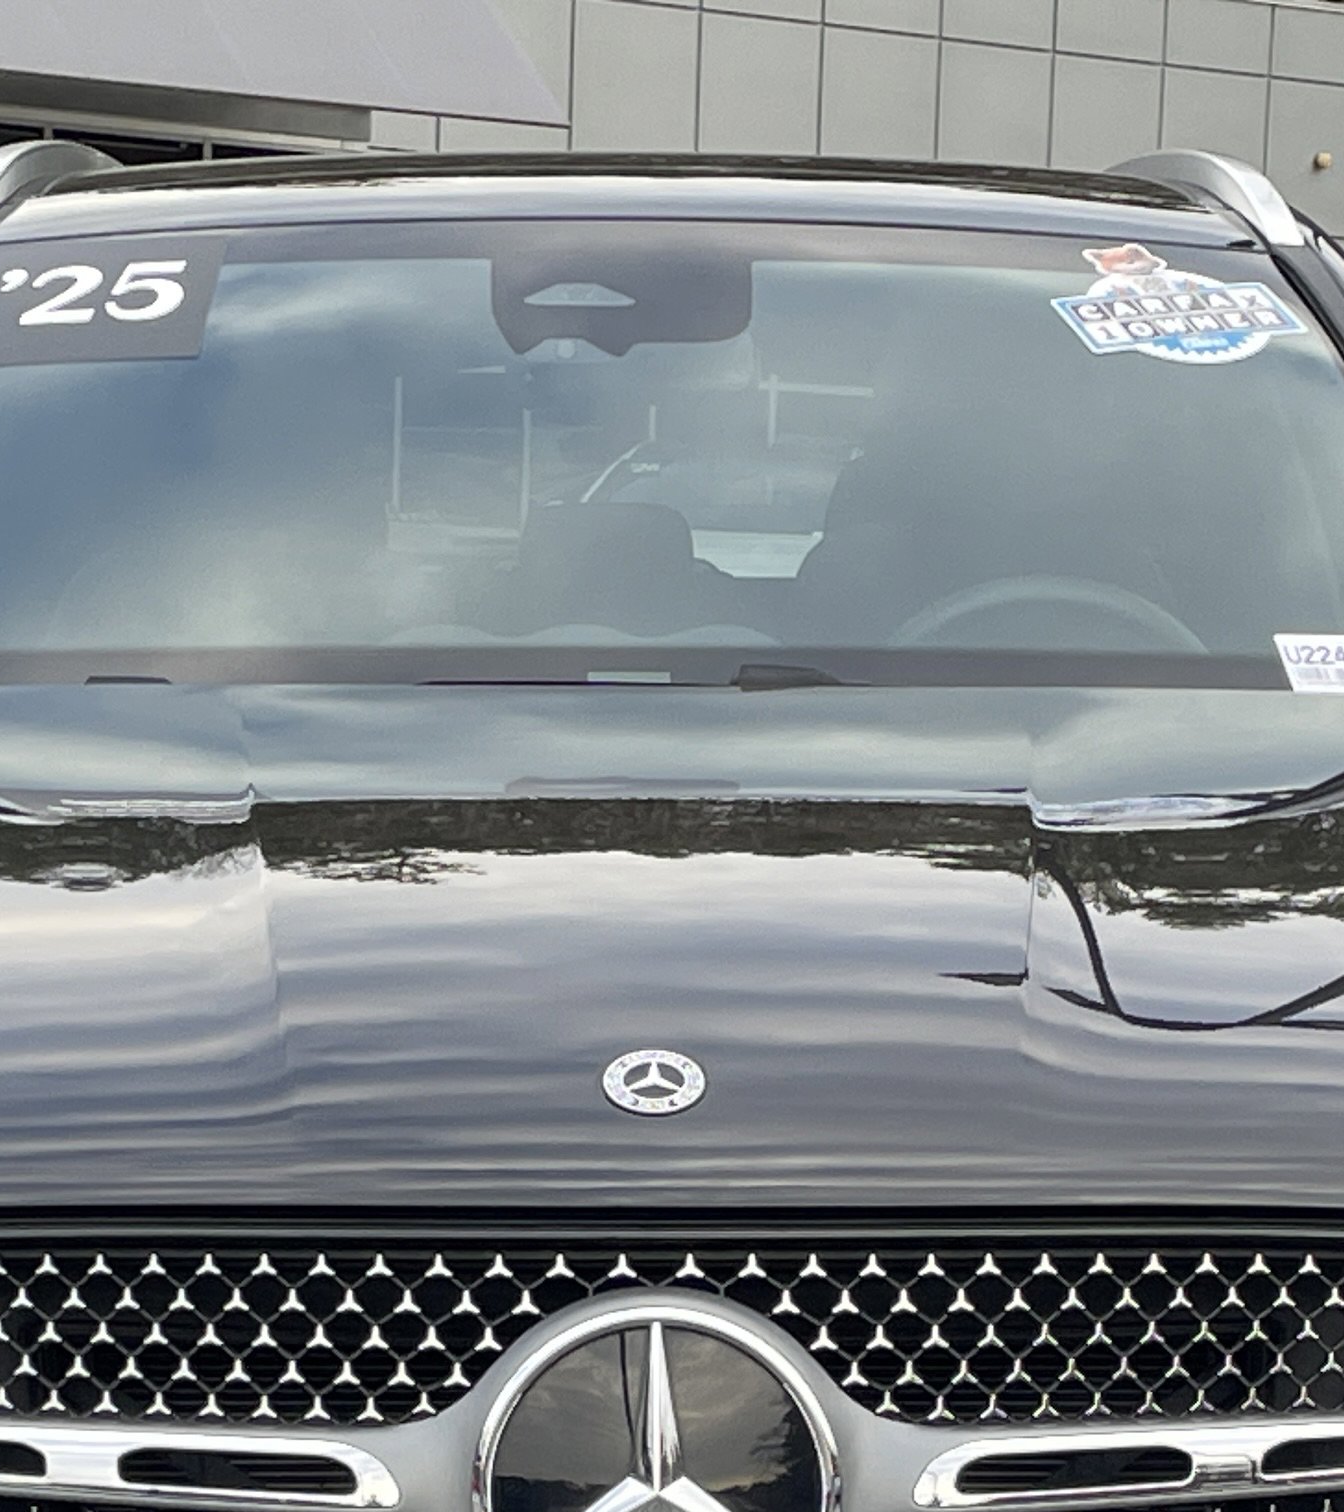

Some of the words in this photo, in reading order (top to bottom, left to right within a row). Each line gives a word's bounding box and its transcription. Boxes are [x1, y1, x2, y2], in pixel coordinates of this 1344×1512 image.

[1076, 292, 1267, 324] CARFAX
[1094, 322, 1117, 341] 1
[1126, 310, 1284, 339] OWNER
